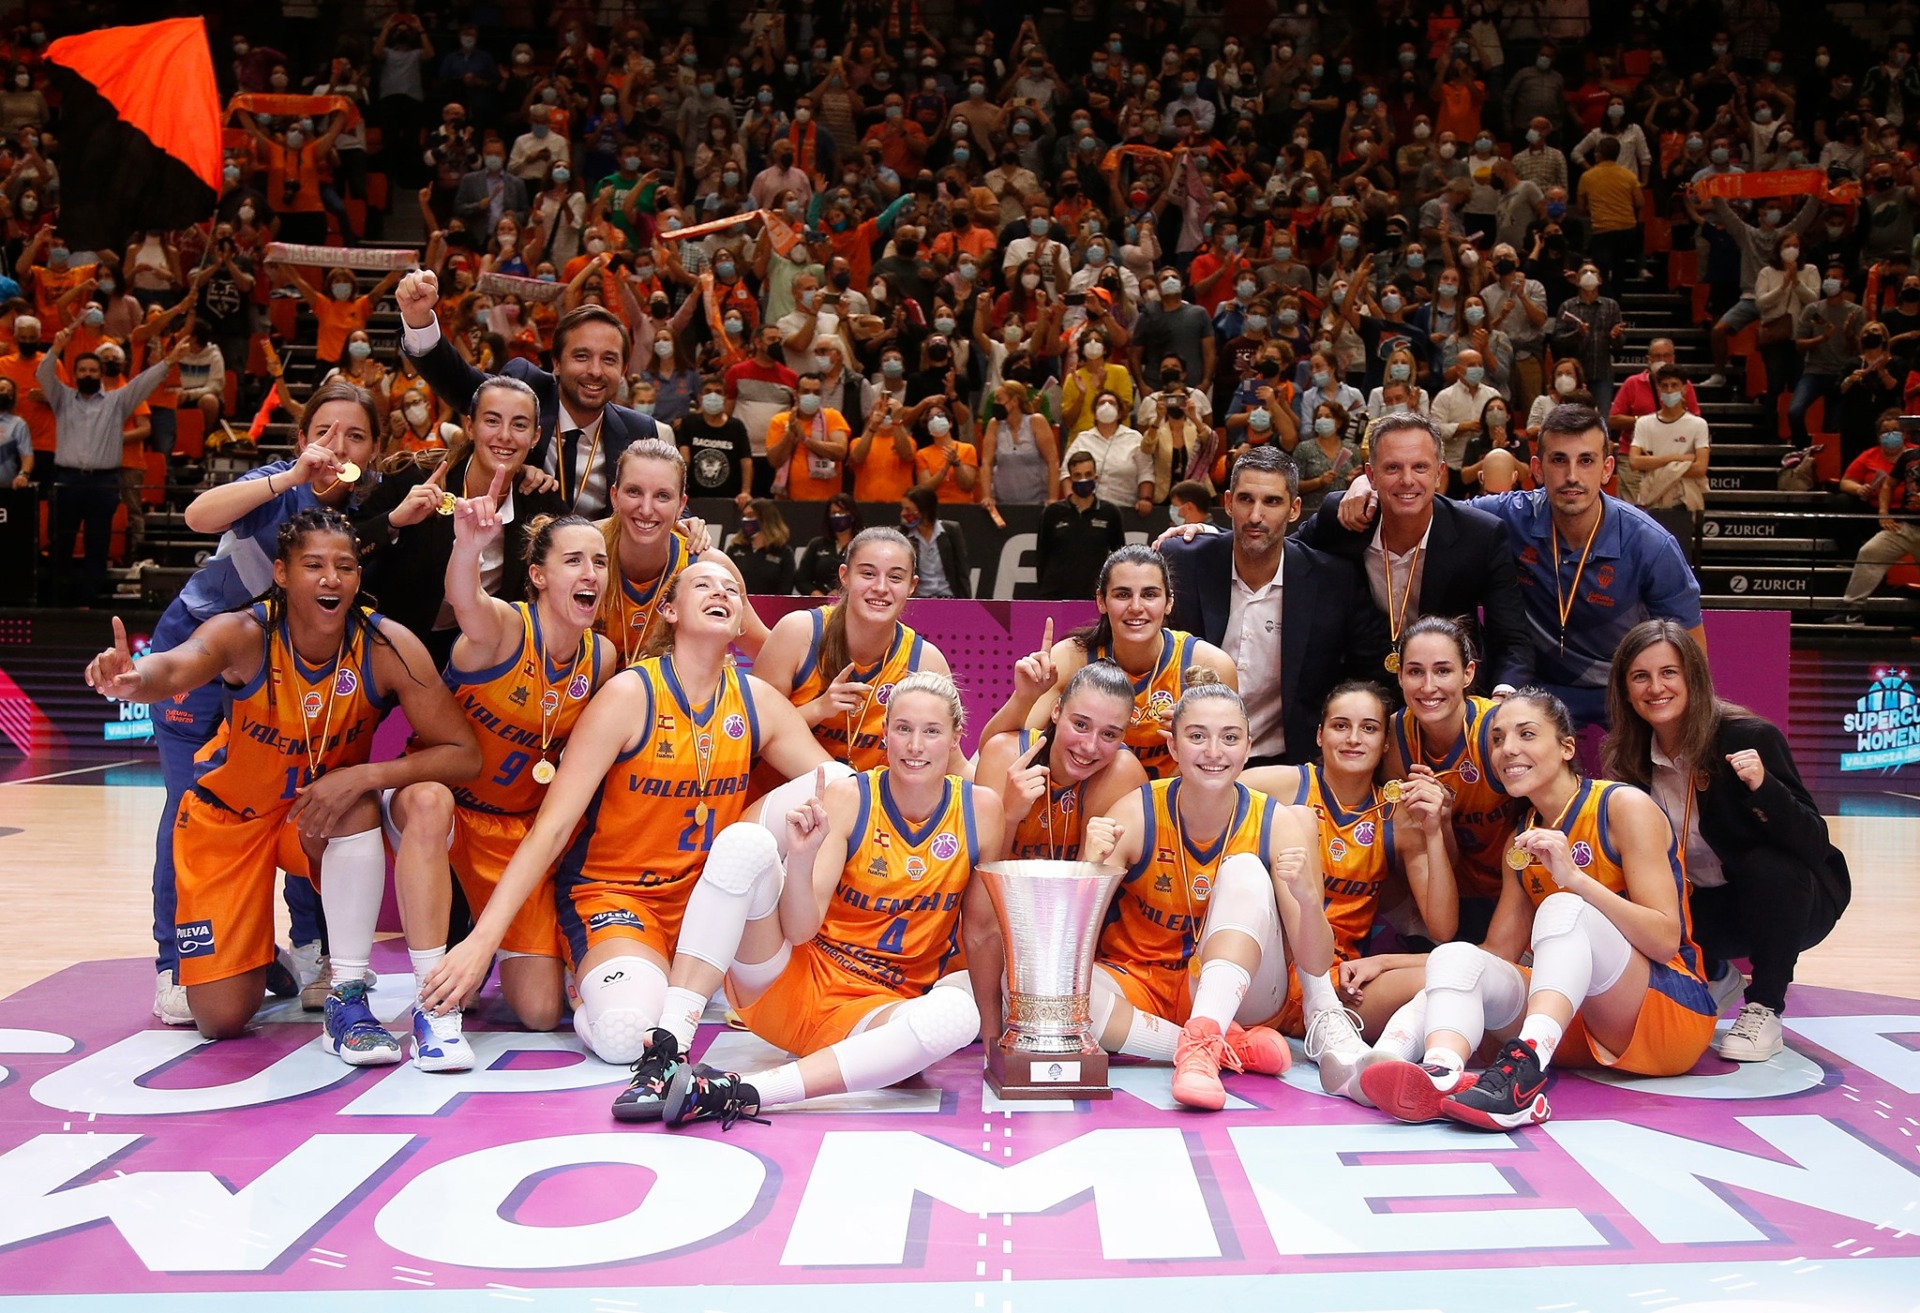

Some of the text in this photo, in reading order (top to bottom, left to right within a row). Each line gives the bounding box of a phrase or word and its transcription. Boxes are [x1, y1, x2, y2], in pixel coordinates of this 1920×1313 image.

[1710, 478, 1741, 489] RICH
[1724, 524, 1775, 536] ZURICH
[1753, 579, 1806, 591] ZURICH
[492, 751, 530, 786] 9
[629, 774, 738, 798] VALENCIA
[677, 808, 716, 852] 21
[1135, 894, 1200, 932] VALEN
[176, 926, 210, 938] PULEVA
[877, 917, 909, 954] 4
